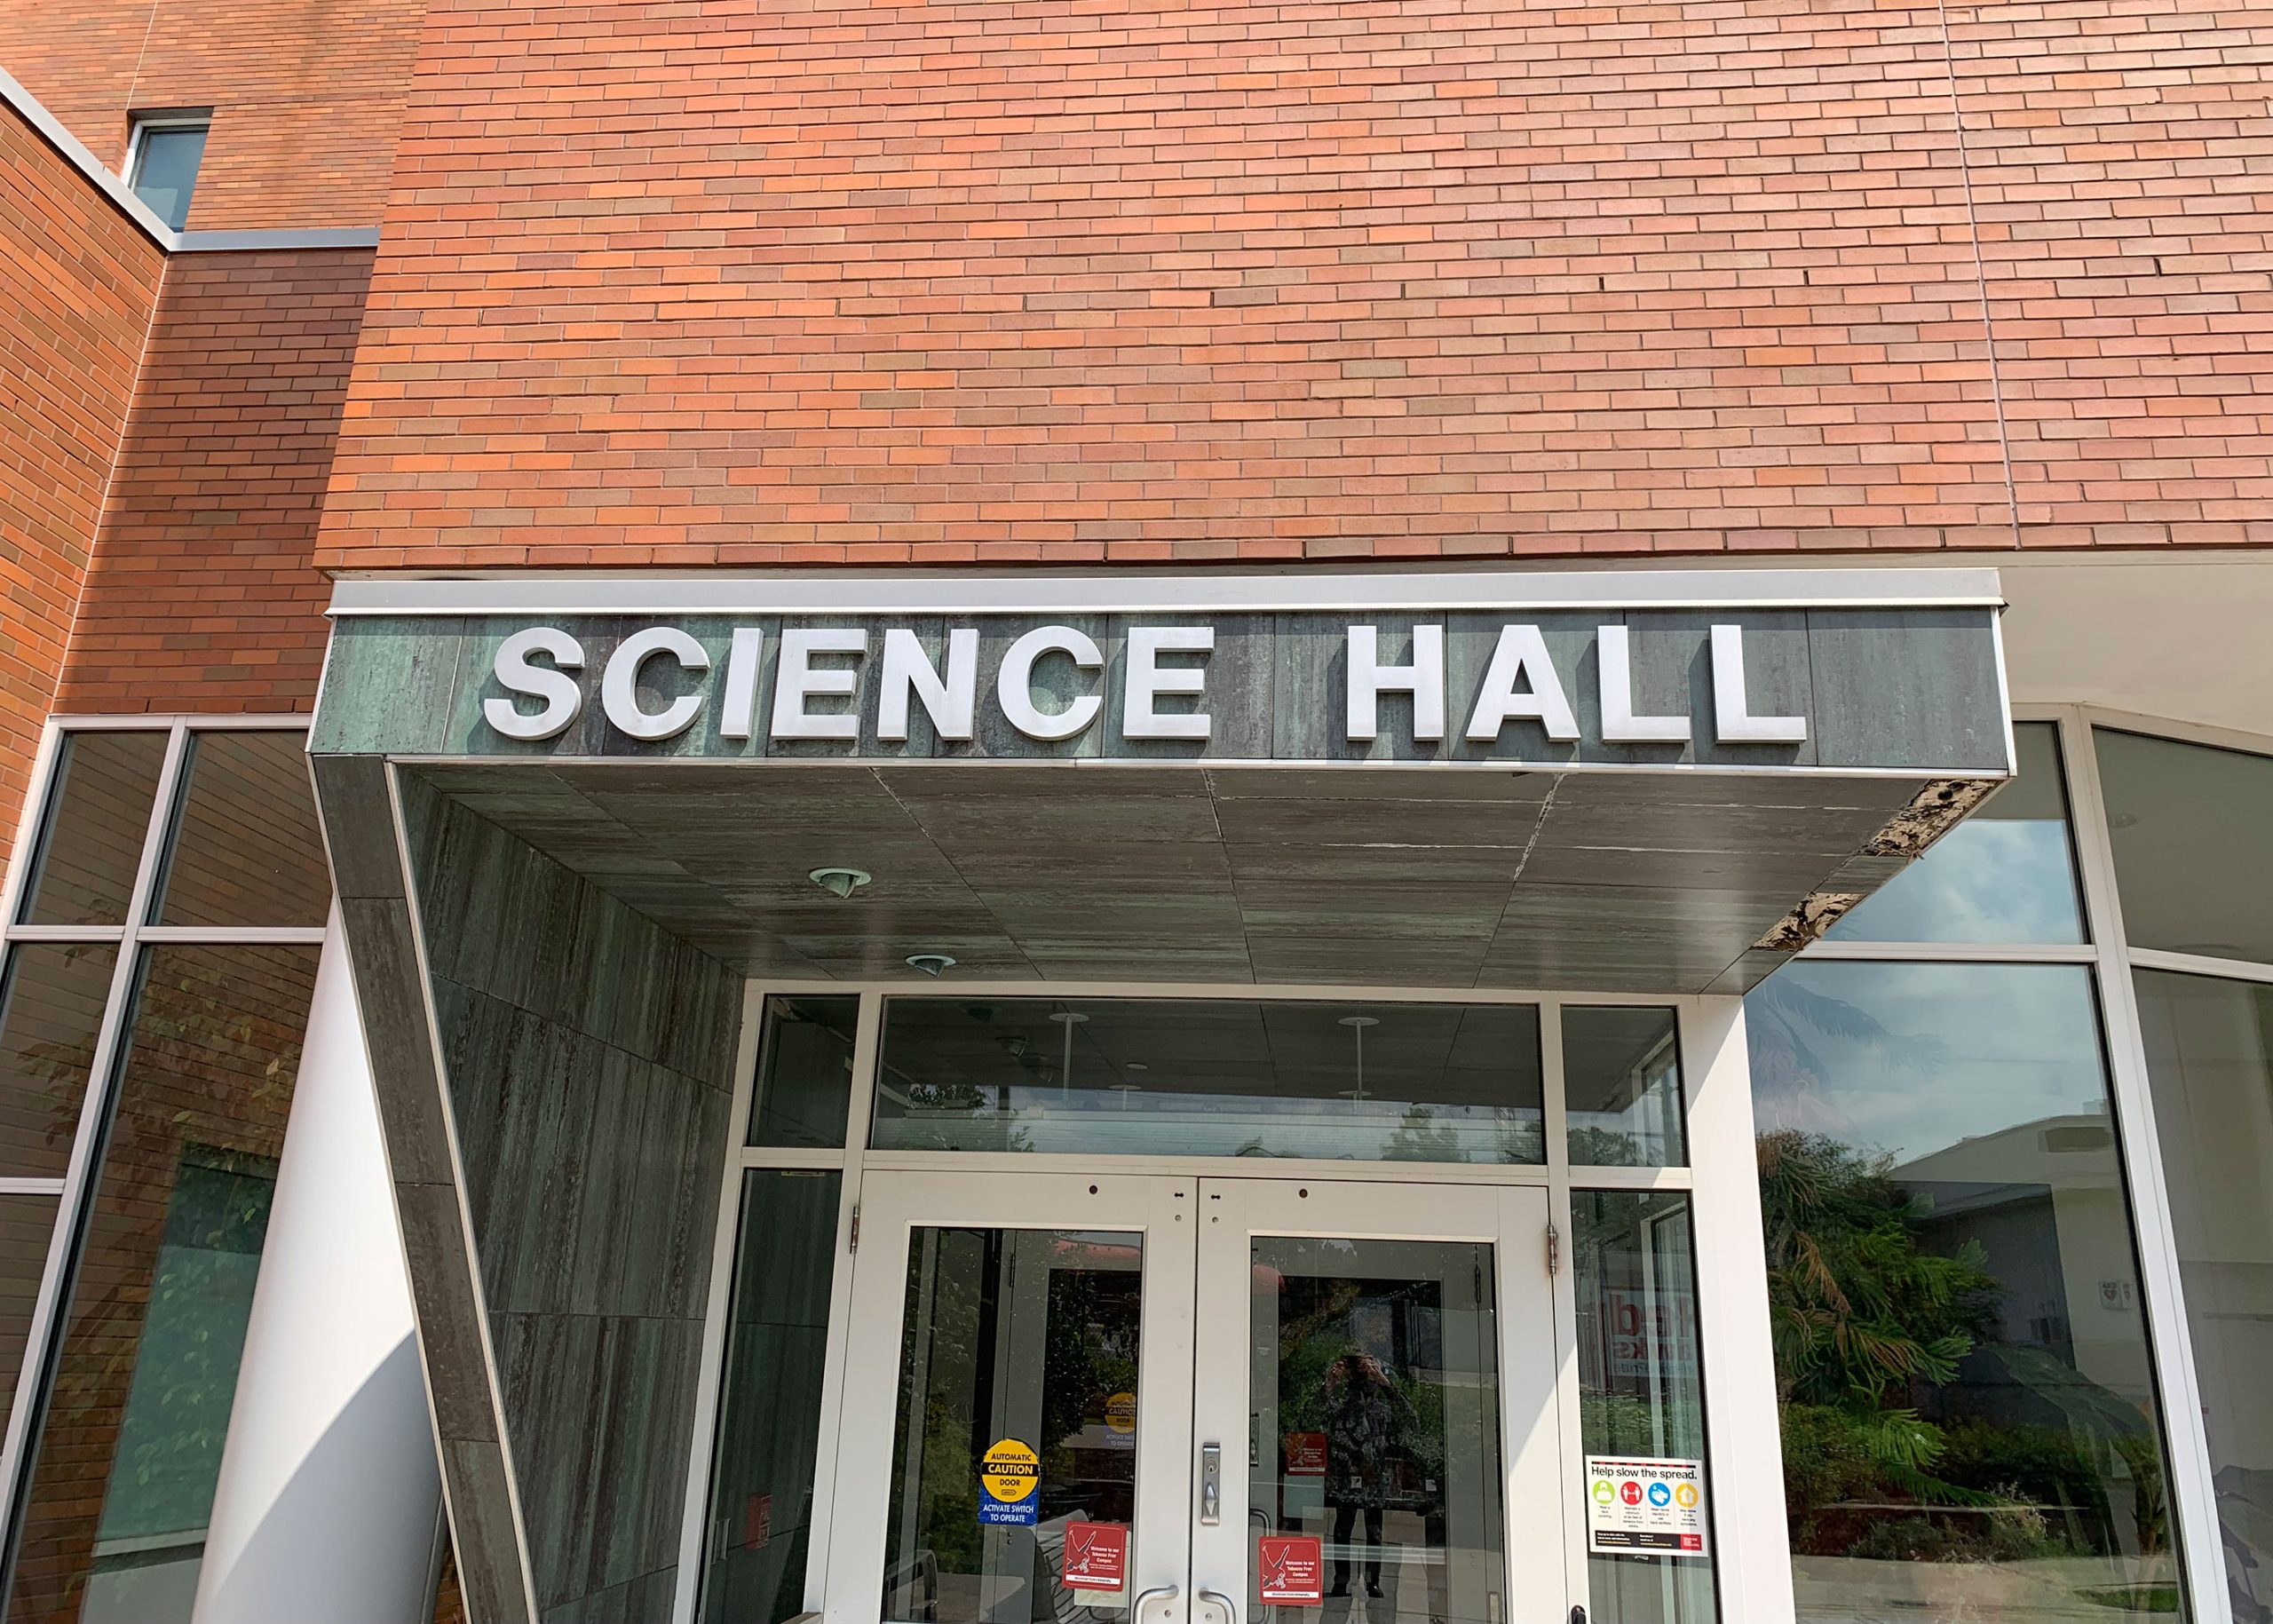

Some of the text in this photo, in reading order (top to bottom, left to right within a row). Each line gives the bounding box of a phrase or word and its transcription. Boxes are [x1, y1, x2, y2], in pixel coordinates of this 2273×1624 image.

[484, 623, 1807, 744] SCIENCE HALL
[991, 1453, 1032, 1462] AUTOMATIC
[987, 1463, 1034, 1475] CAUTION
[1591, 1466, 1698, 1480] Help slow the spread.
